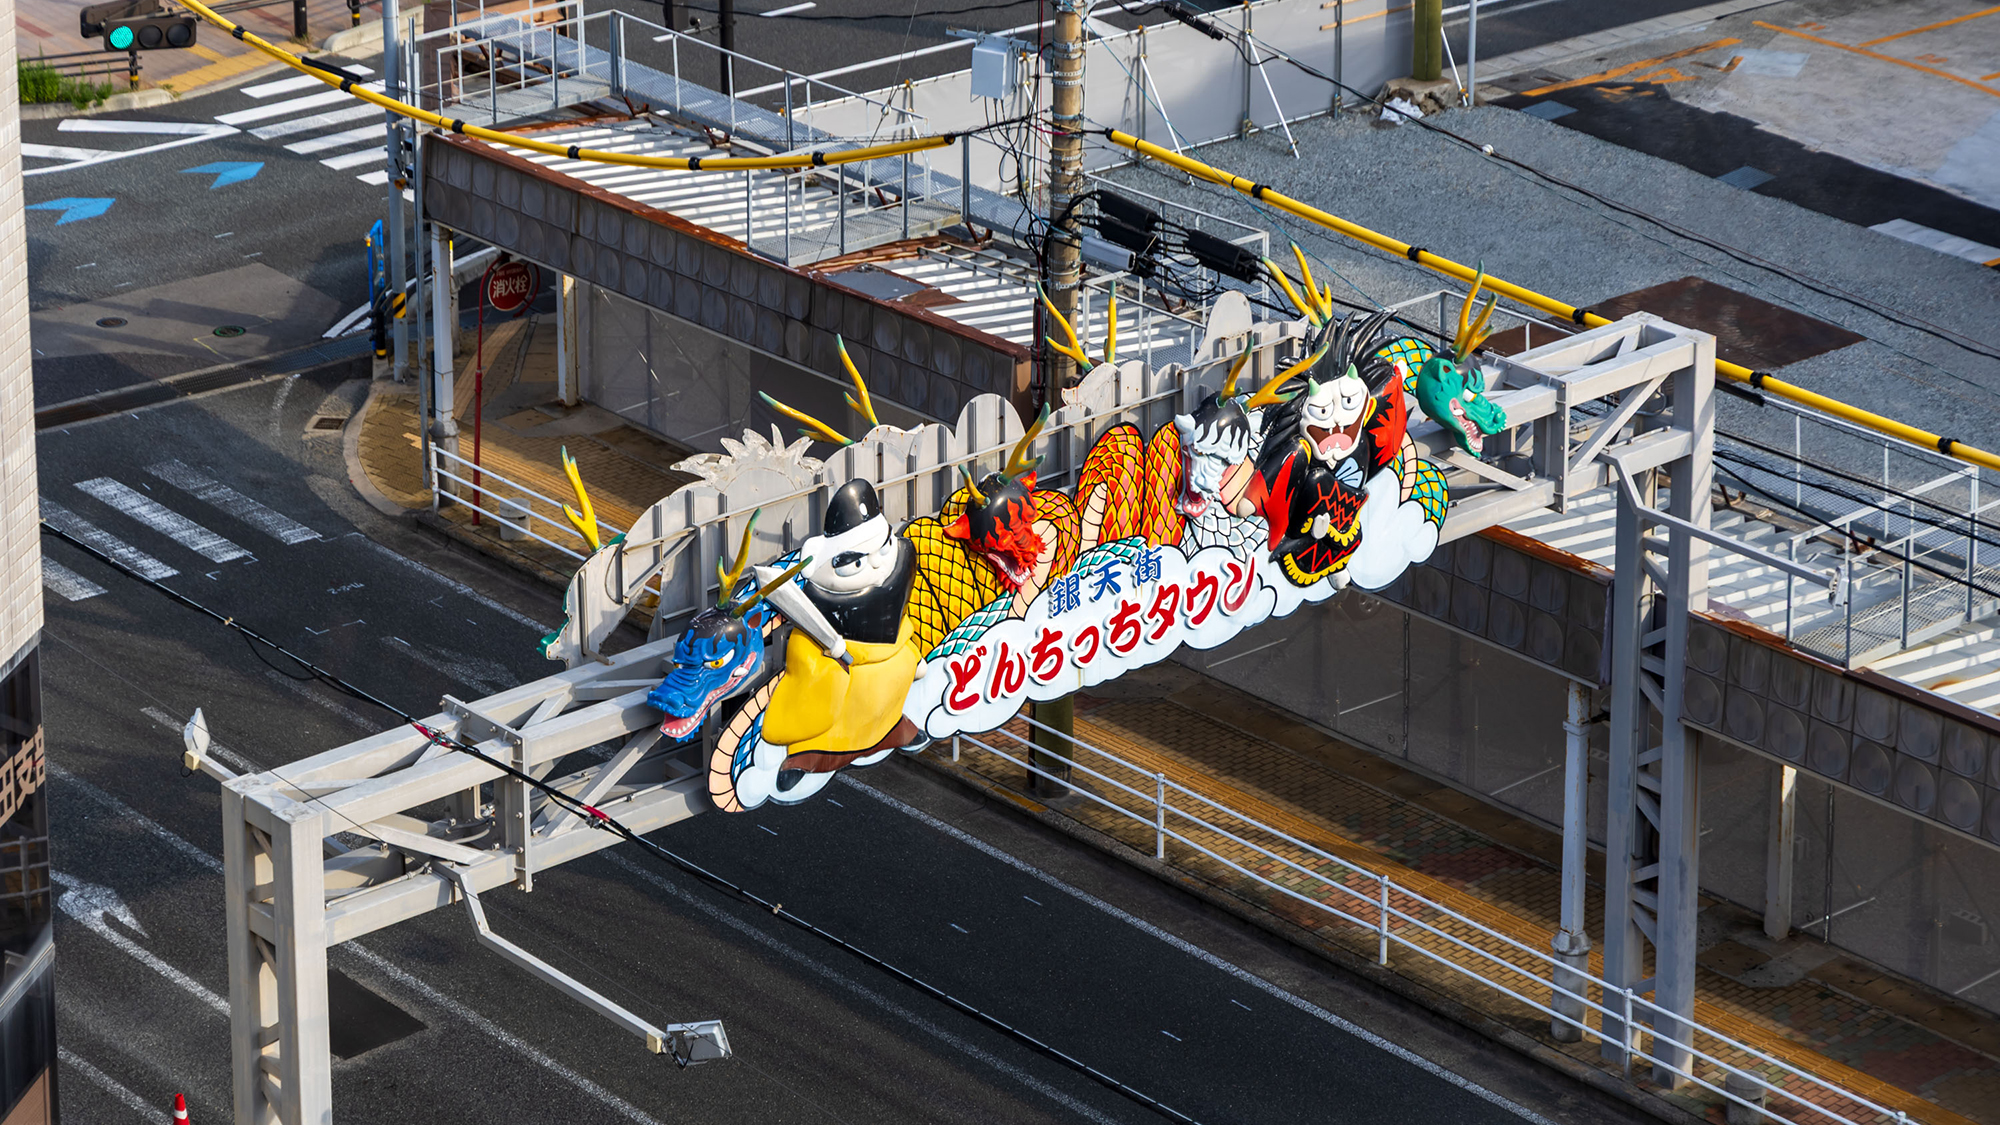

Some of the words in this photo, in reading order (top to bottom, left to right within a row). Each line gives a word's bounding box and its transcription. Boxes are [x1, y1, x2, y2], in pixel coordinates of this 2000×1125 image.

[492, 274, 528, 299] 消火栓
[1052, 546, 1163, 617] 銀天街
[949, 556, 1255, 711] どんちっちタウン
